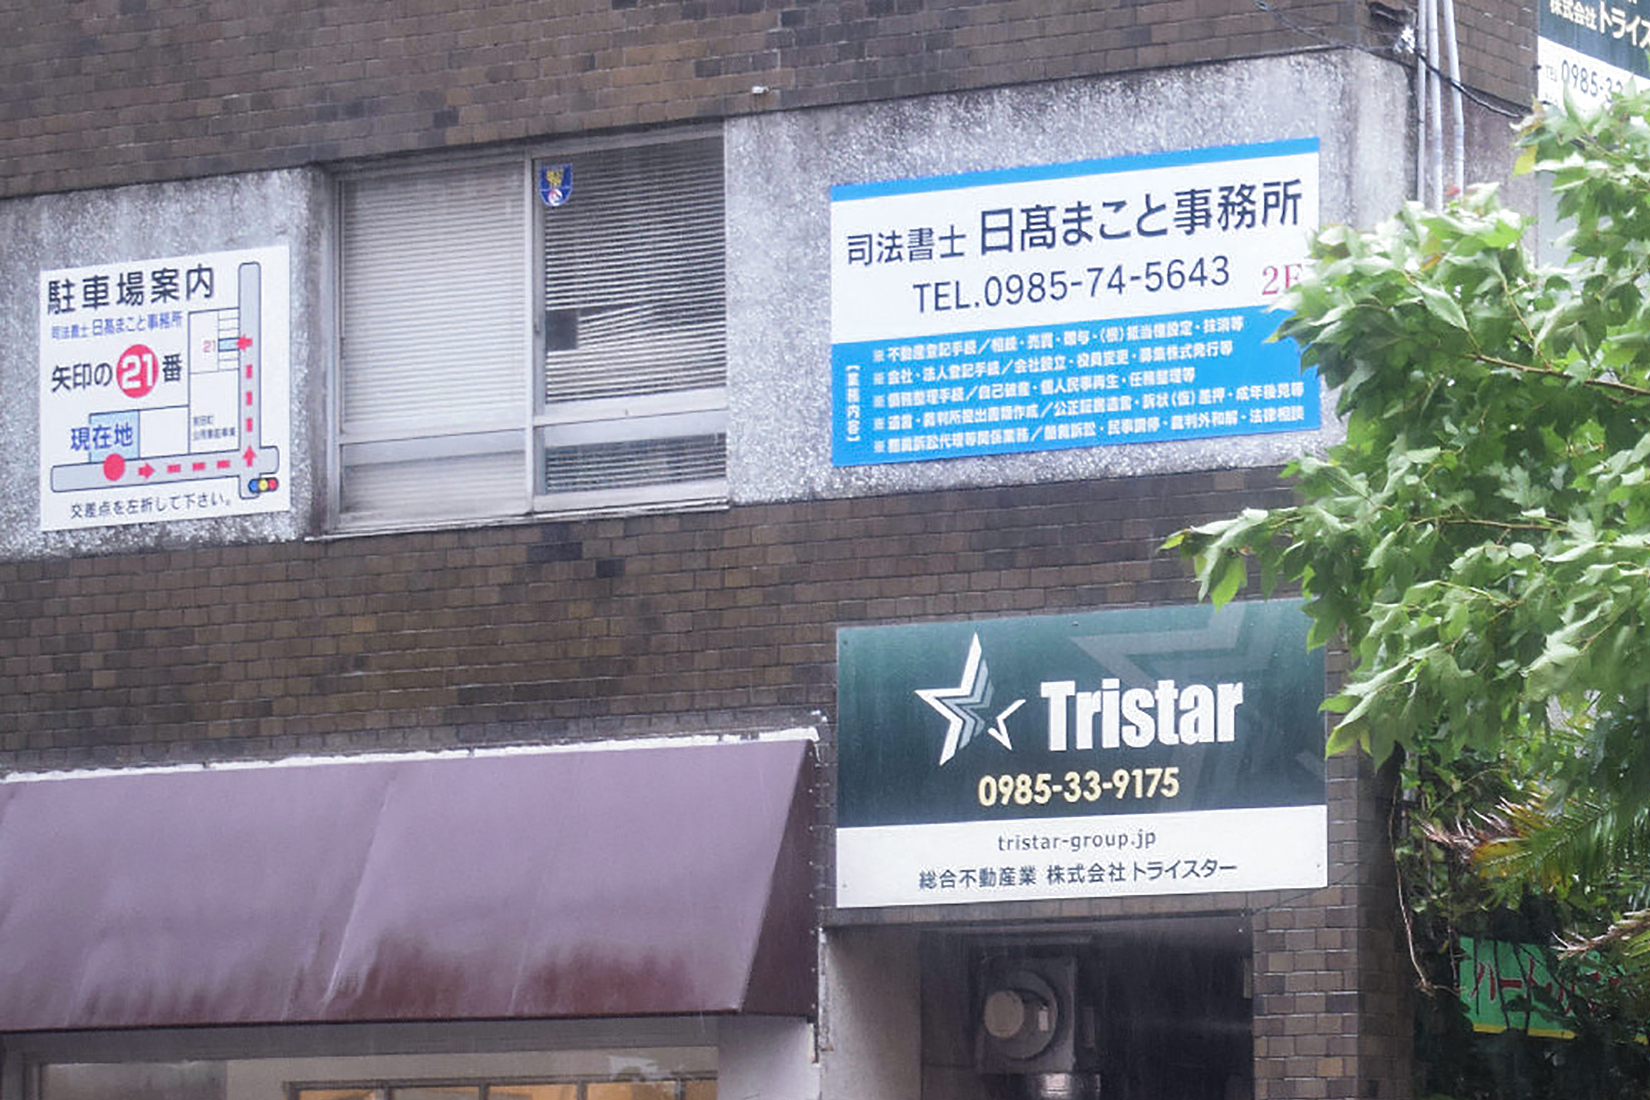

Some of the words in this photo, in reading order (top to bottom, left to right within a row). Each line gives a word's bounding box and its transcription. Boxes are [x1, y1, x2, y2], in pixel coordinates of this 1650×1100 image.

[847, 224, 966, 266] 司法書士
[48, 263, 214, 315] 駐車場案内
[1262, 263, 1302, 296] 2F
[71, 422, 133, 451] 現在地
[1040, 678, 1244, 751] Tristar
[978, 767, 1180, 806] 0985-33-9175
[998, 829, 1156, 853] tristar-group.jp
[918, 865, 1038, 890] 総合不動産業
[1046, 857, 1238, 886] 株式会社トライスター
